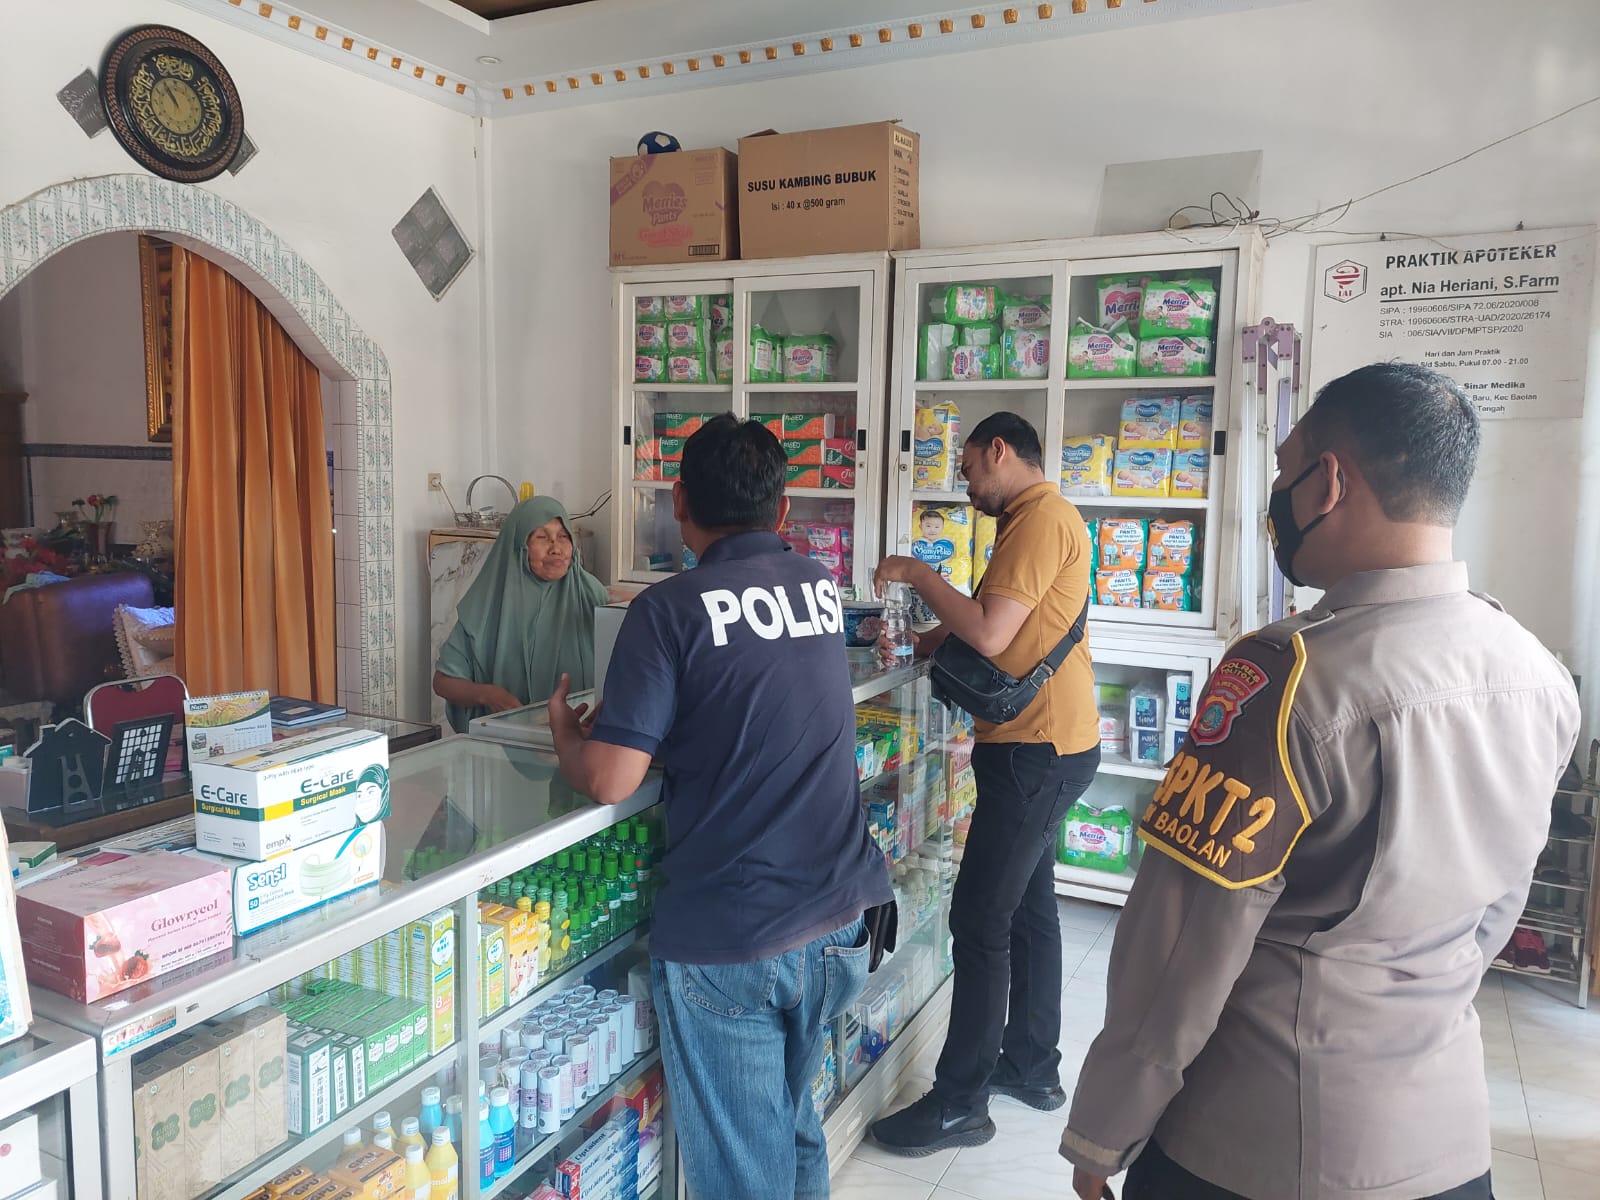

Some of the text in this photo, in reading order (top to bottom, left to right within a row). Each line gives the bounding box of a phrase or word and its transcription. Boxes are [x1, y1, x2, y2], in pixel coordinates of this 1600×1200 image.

[747, 170, 877, 193] SUSU KAMBING BUBUK
[771, 201, 780, 211] Isi
[786, 201, 795, 210] 40
[803, 198, 824, 210] @500
[826, 198, 846, 209] gram
[1385, 244, 1557, 269] PRAKTIK APOTEKER
[1380, 274, 1560, 299] apt. Nia Heriani, S.Farm
[1105, 301, 1140, 317] Merri
[1162, 298, 1190, 306] Merries
[1379, 307, 1401, 315] SIPA
[1378, 331, 1393, 339] SIA
[1087, 342, 1113, 350] Merries
[1157, 344, 1185, 352] Merries
[1474, 348, 1501, 356] Praktik
[1459, 359, 1481, 367] Pukul
[1463, 382, 1489, 390] Sinar
[300, 769, 355, 794] E-Care
[200, 784, 248, 806] E-Care
[300, 786, 347, 807] Surgical Mask
[201, 802, 241, 816] Surgical Mask
[1079, 831, 1108, 842] Merries
[1153, 810, 1232, 868] BAOLAN
[151, 898, 219, 932] Glowrycol
[574, 1132, 607, 1161] Ciptadent
[347, 1151, 377, 1169] GPU
[272, 1168, 304, 1186] GPU
[293, 1177, 321, 1196] GPU
